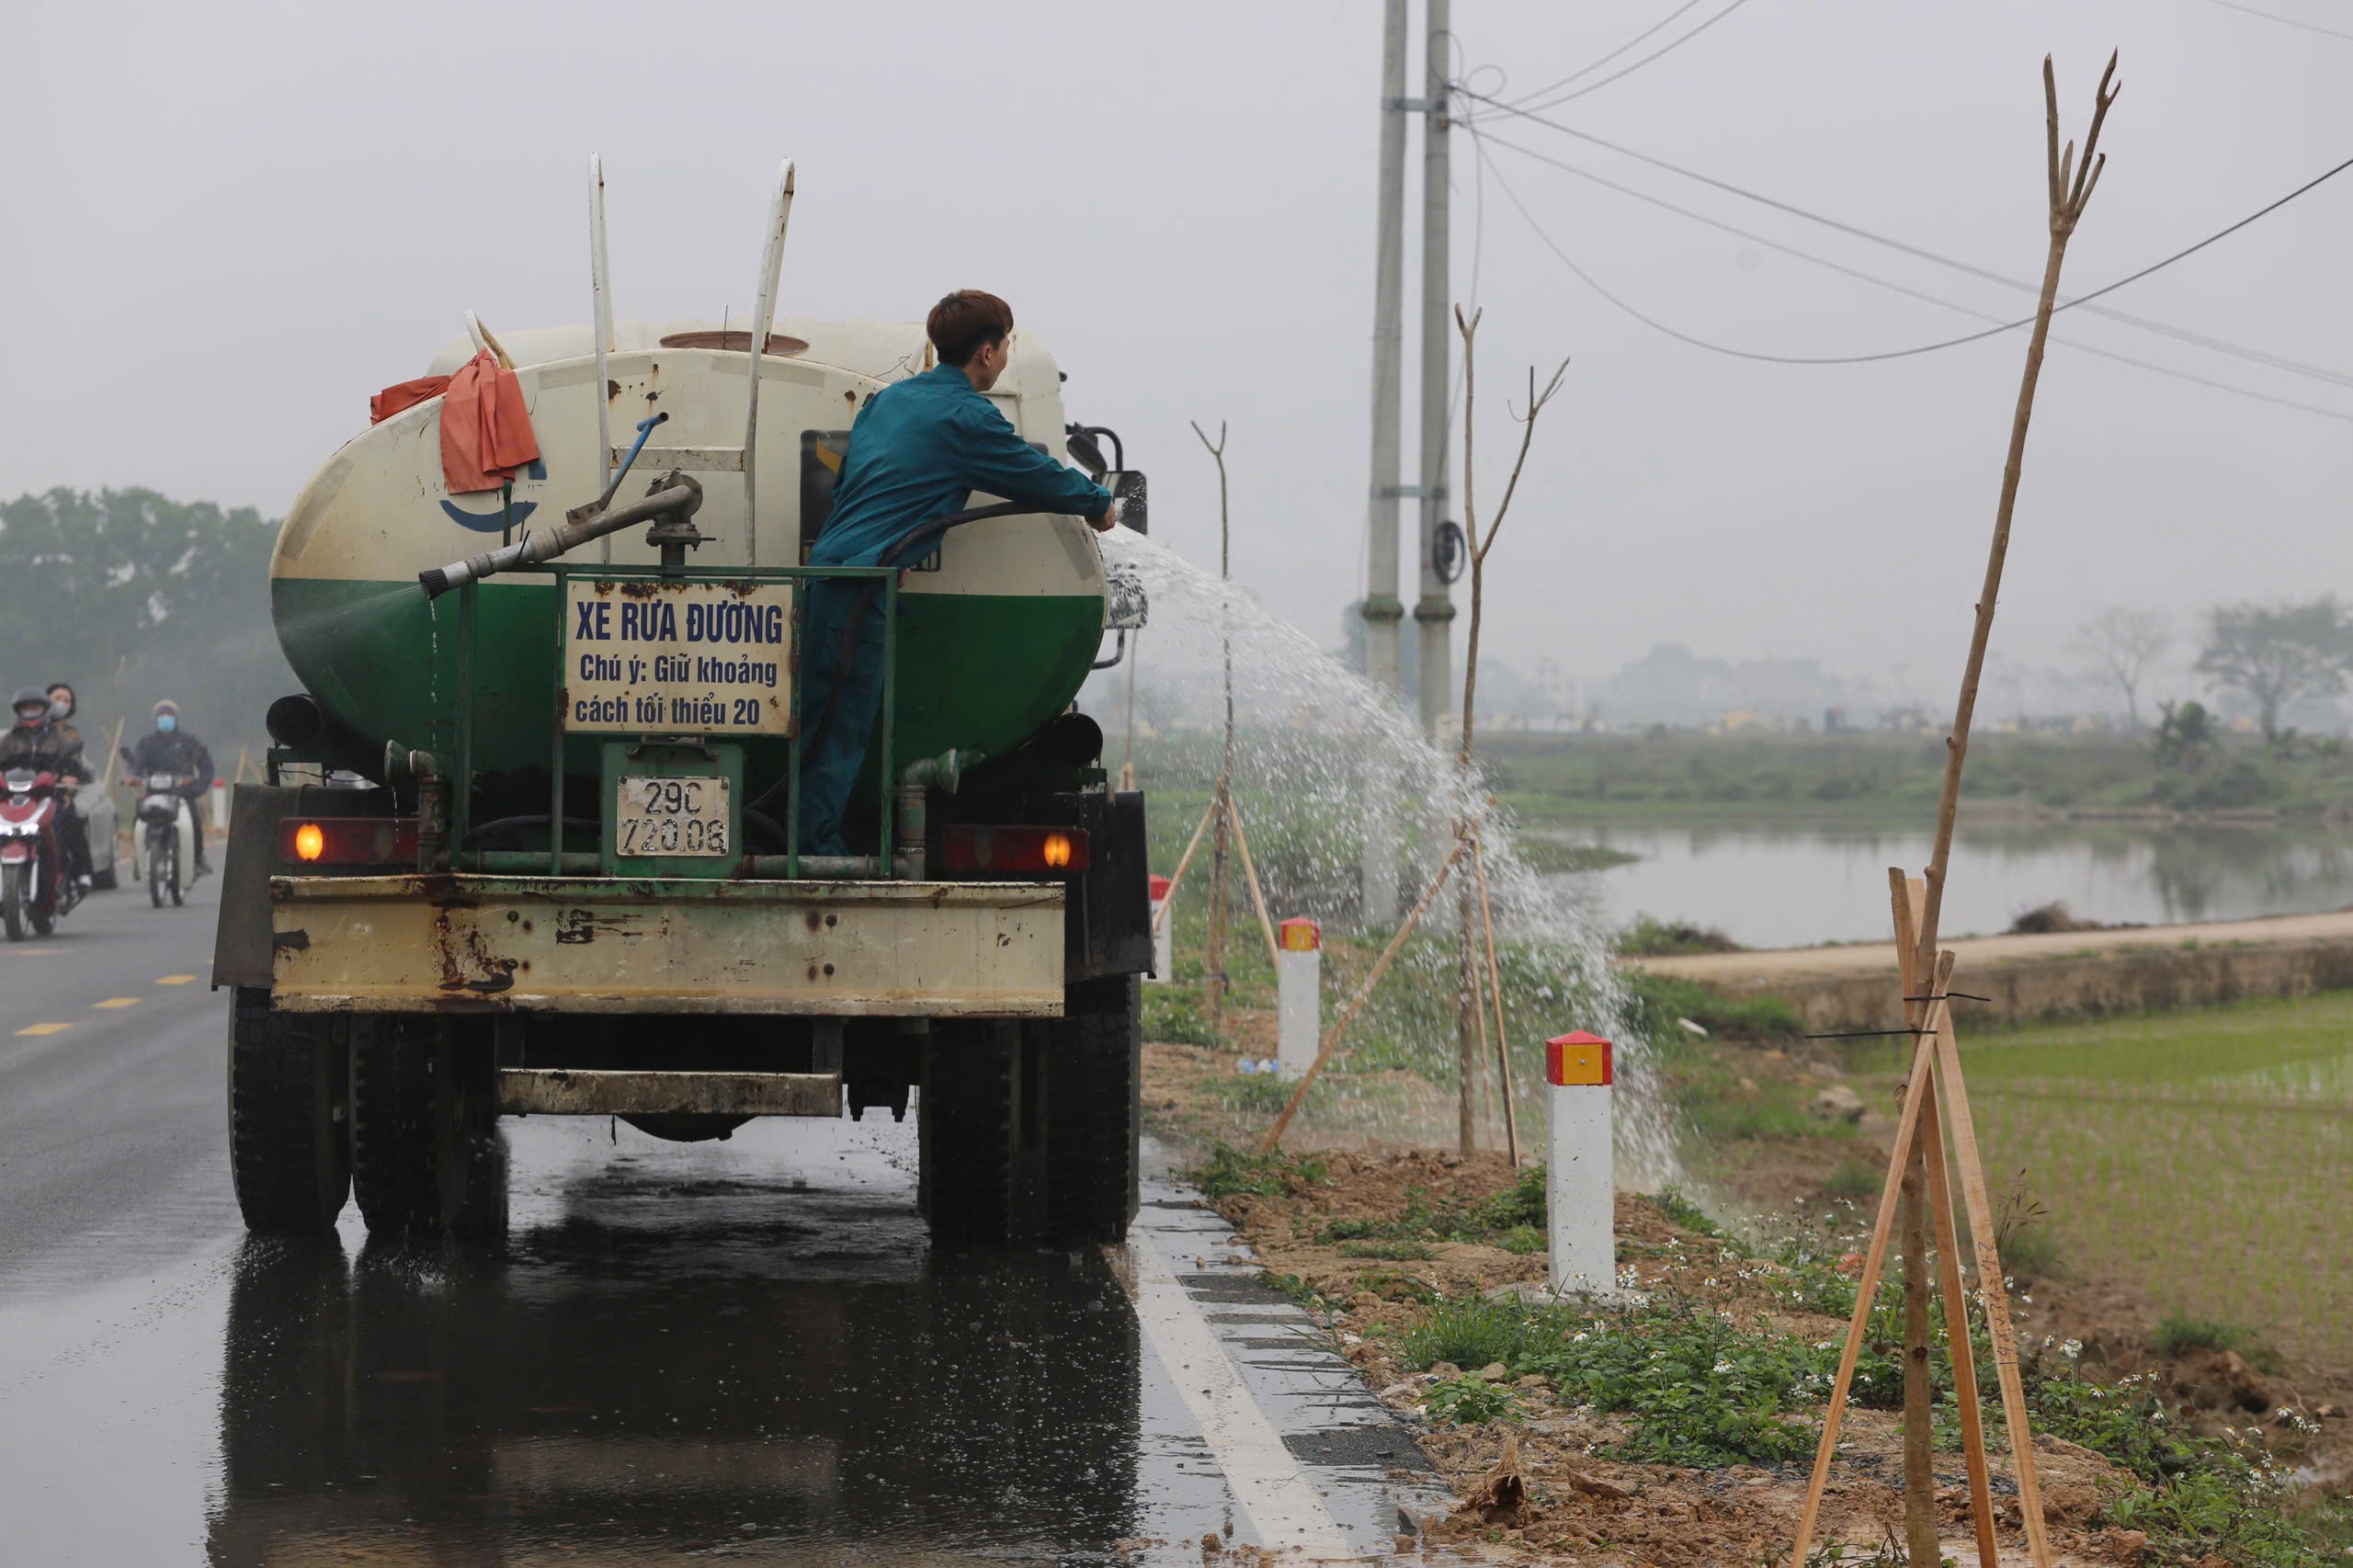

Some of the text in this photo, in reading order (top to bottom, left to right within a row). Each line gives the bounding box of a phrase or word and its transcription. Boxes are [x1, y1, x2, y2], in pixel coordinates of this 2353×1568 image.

[575, 601, 611, 641] XE
[687, 593, 782, 644] ĐƯỜNG
[580, 653, 777, 687] Chú ý: Giữ khoảng
[575, 692, 760, 725] cách tối thiểu 20
[645, 781, 702, 814] 29C
